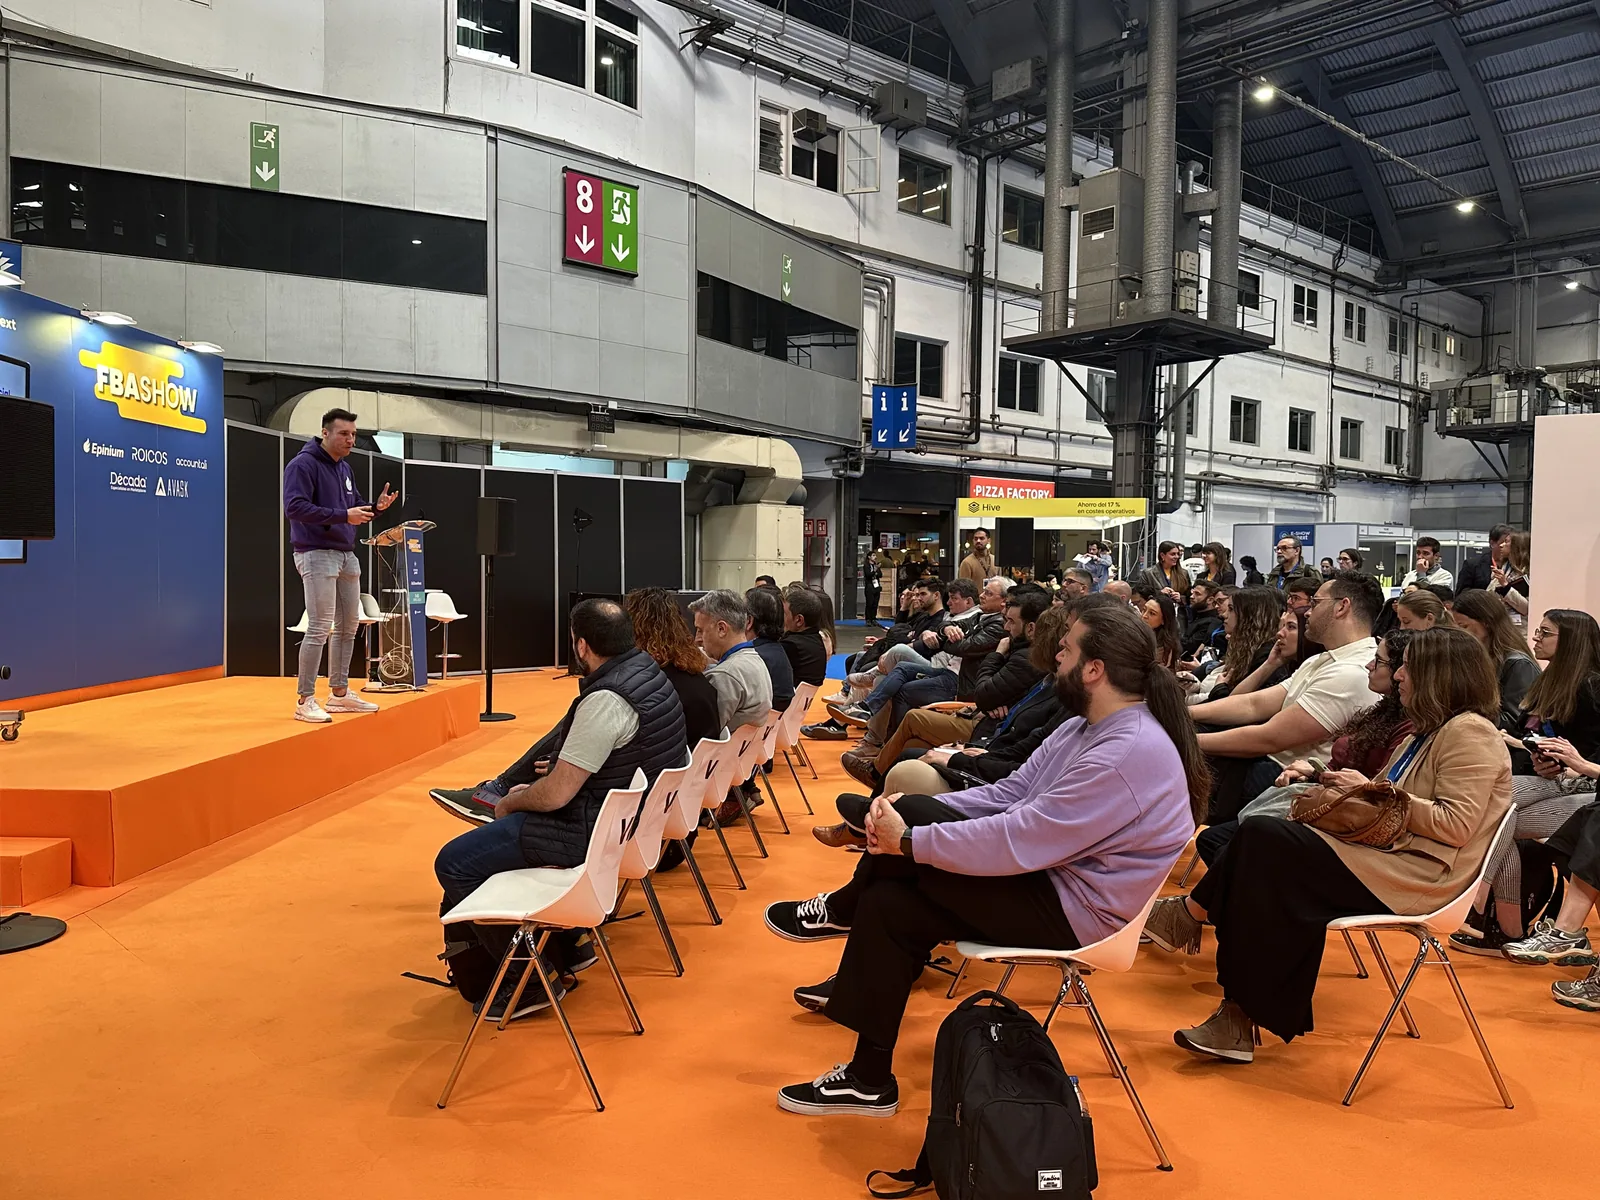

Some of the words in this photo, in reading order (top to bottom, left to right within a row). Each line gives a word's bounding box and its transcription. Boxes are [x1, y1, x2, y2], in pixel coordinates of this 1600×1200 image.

[576, 179, 594, 214] 8
[96, 364, 198, 413] FBASHOW
[91, 442, 124, 458] Epinium
[131, 446, 168, 465] ROICOS
[110, 471, 147, 488] Década
[975, 484, 1005, 498] PIZZA
[1007, 487, 1050, 499] FACTORY
[982, 503, 1001, 512] Hive
